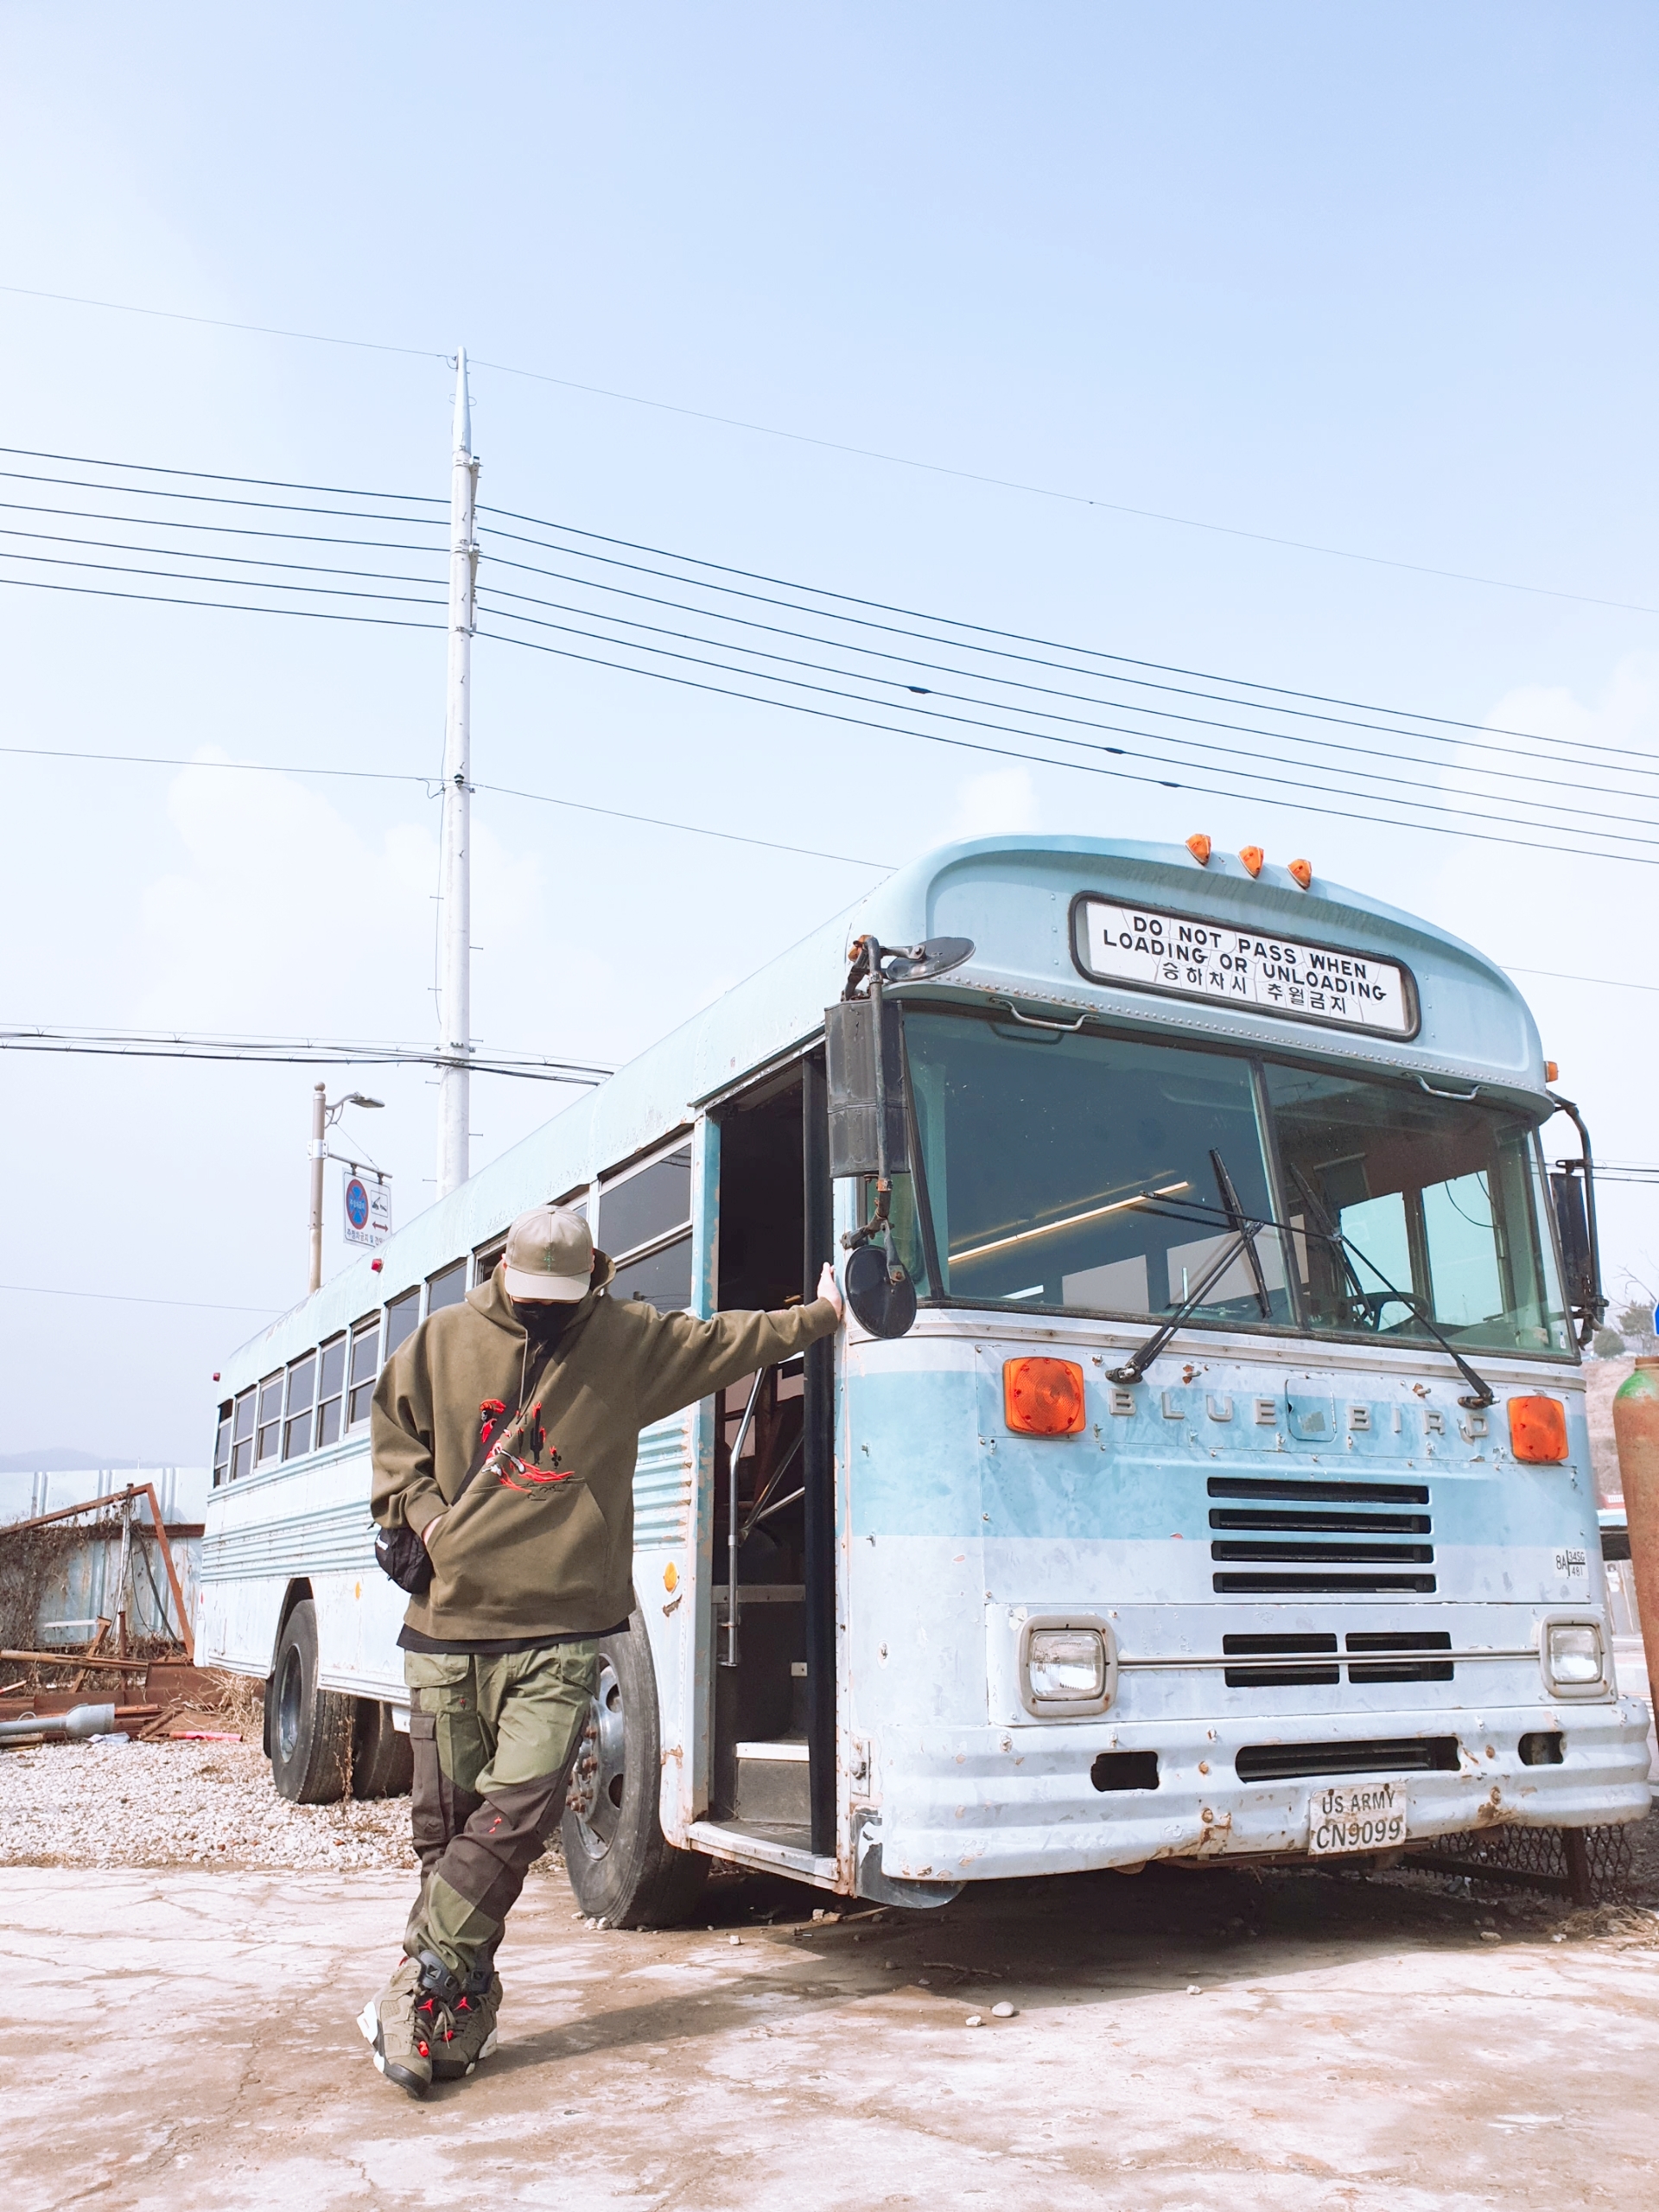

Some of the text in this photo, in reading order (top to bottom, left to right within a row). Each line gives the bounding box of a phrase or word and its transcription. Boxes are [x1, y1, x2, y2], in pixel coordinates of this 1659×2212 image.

[1103, 929, 1387, 1002] LOADING OR UNLOADING
[1134, 916, 1366, 979] DO NOT PASS WHEN
[1162, 961, 1346, 1014] 승하차시 추월금지
[1109, 1388, 1491, 1438] BLUE BIRD
[1322, 1789, 1395, 1815] US ARMY
[1317, 1819, 1401, 1849] CN9099
